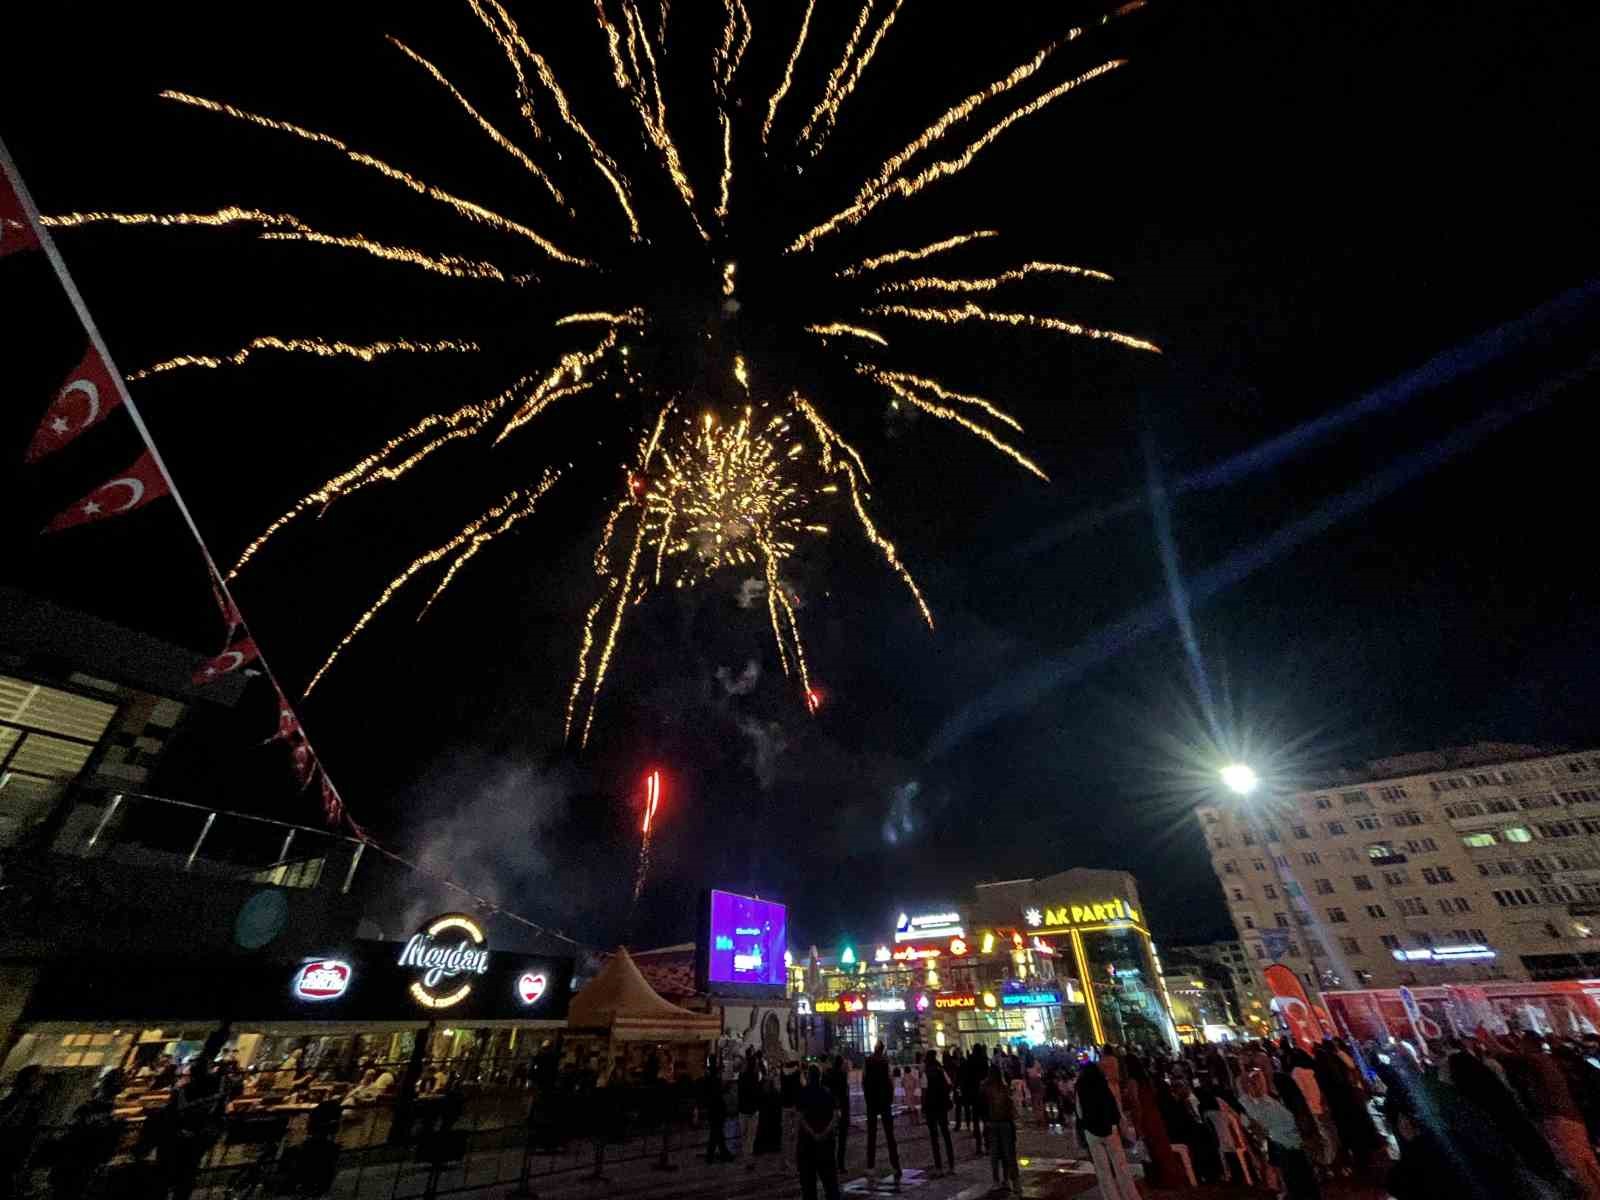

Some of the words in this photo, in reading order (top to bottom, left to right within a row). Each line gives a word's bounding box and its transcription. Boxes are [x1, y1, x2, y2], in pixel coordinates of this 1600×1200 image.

[1045, 908, 1070, 925] AK
[1071, 898, 1124, 922] PARTİ
[398, 933, 488, 987] Meydan
[935, 997, 975, 1008] OYUNCAK
